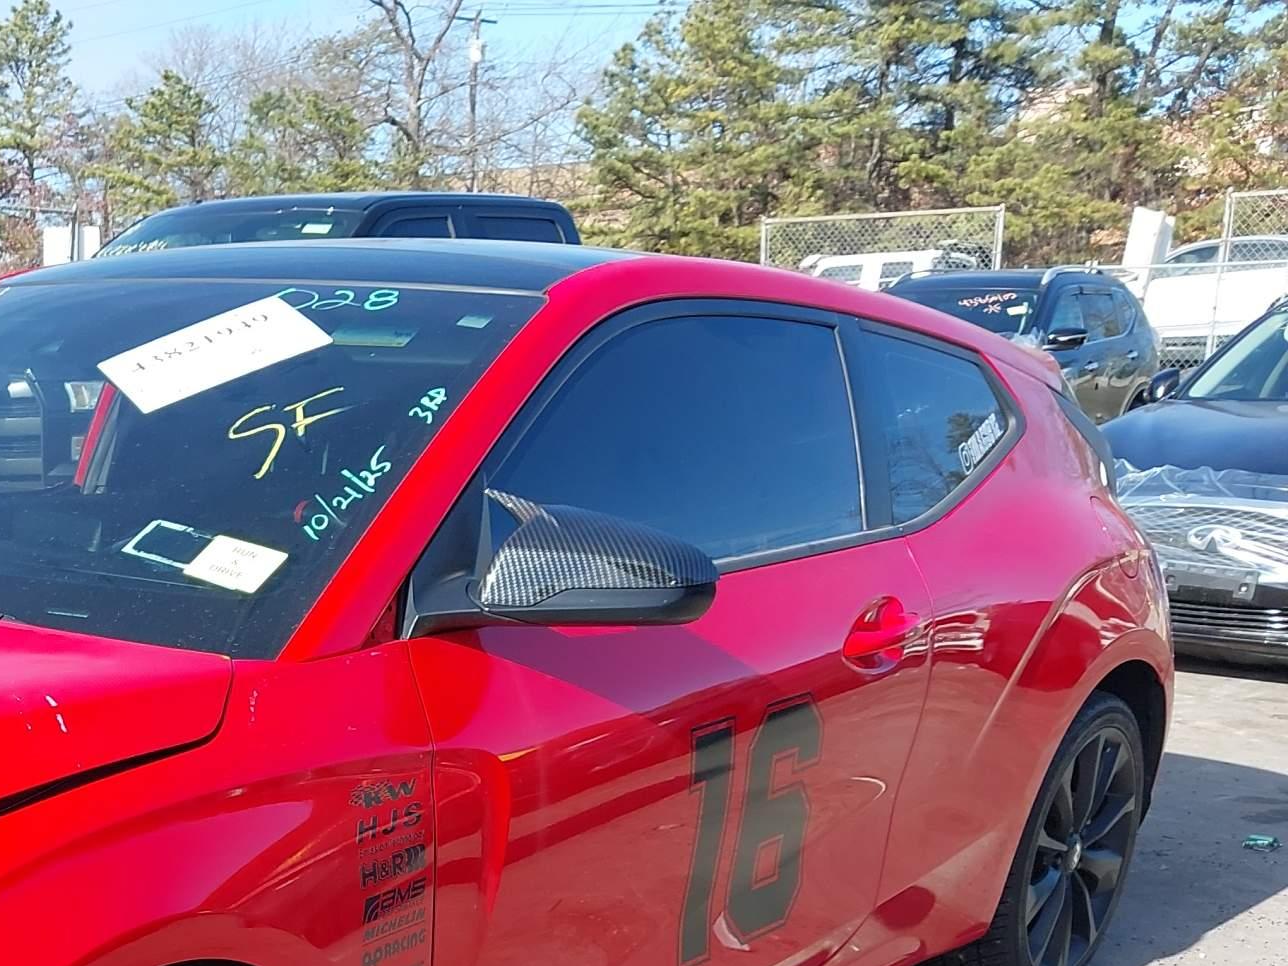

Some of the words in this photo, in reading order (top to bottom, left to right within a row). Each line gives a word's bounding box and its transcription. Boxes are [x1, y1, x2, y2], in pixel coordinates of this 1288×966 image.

[356, 801, 423, 845] HJS
[360, 851, 407, 889] H&R
[364, 908, 425, 940] MICHELIN
